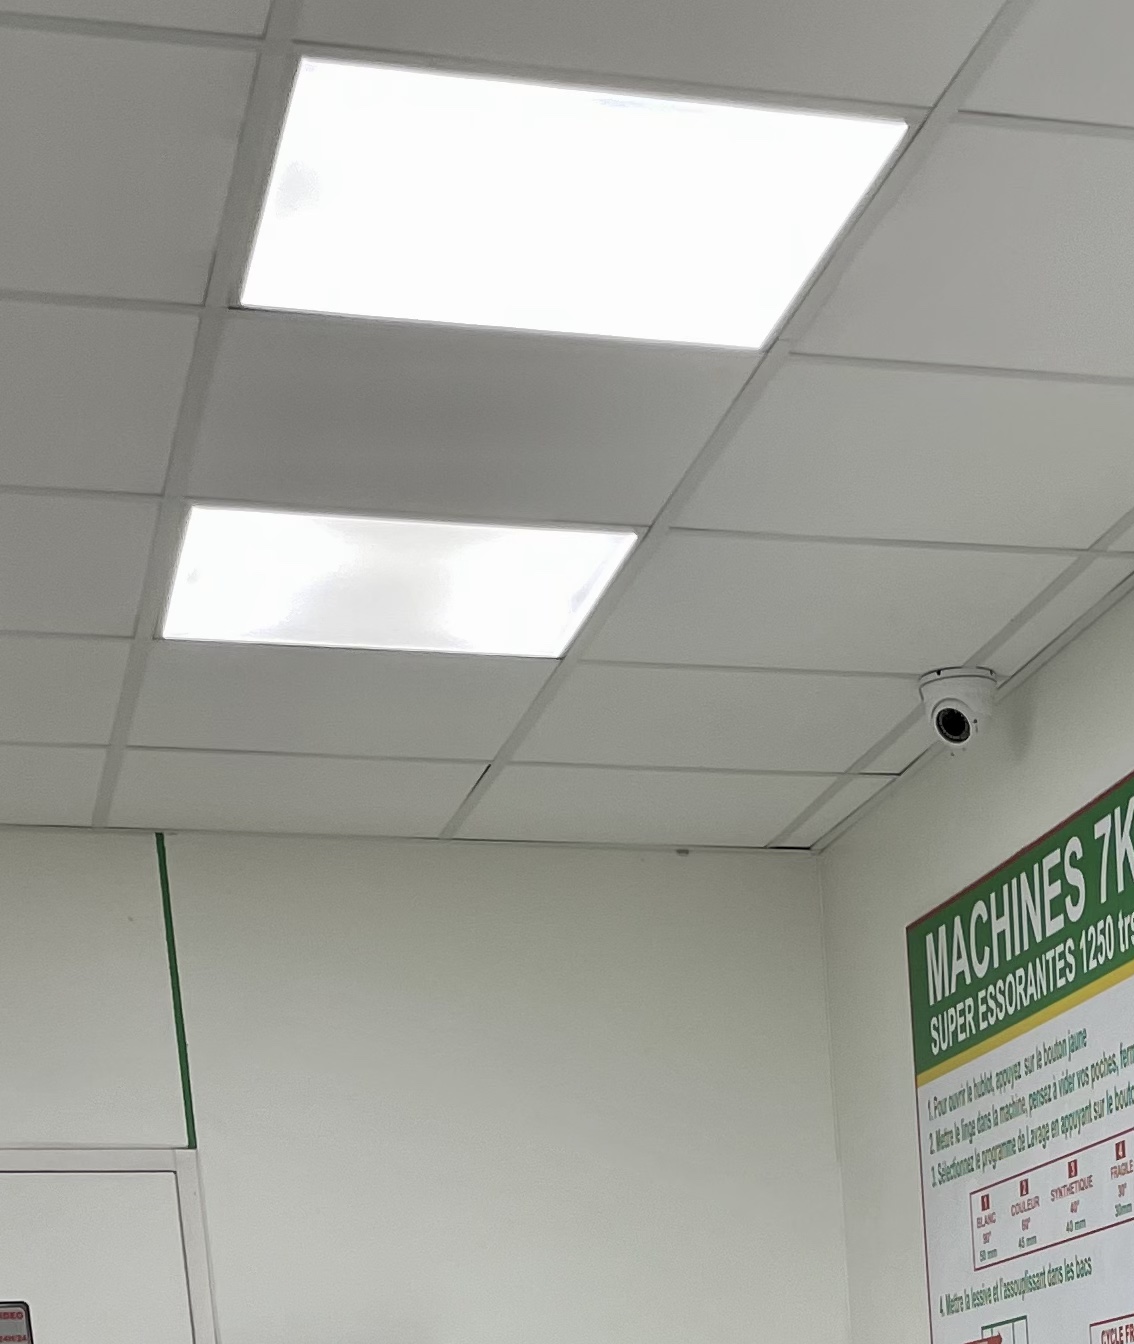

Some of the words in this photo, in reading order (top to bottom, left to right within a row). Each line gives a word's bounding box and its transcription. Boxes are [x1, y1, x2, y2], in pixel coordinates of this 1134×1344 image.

[925, 836, 1085, 1006] MACHINES
[930, 1001, 976, 1056] SUPER
[978, 939, 1075, 1032] ESSORANTES
[1080, 914, 1114, 974] 1250
[1011, 1196, 1040, 1216] COULEUR
